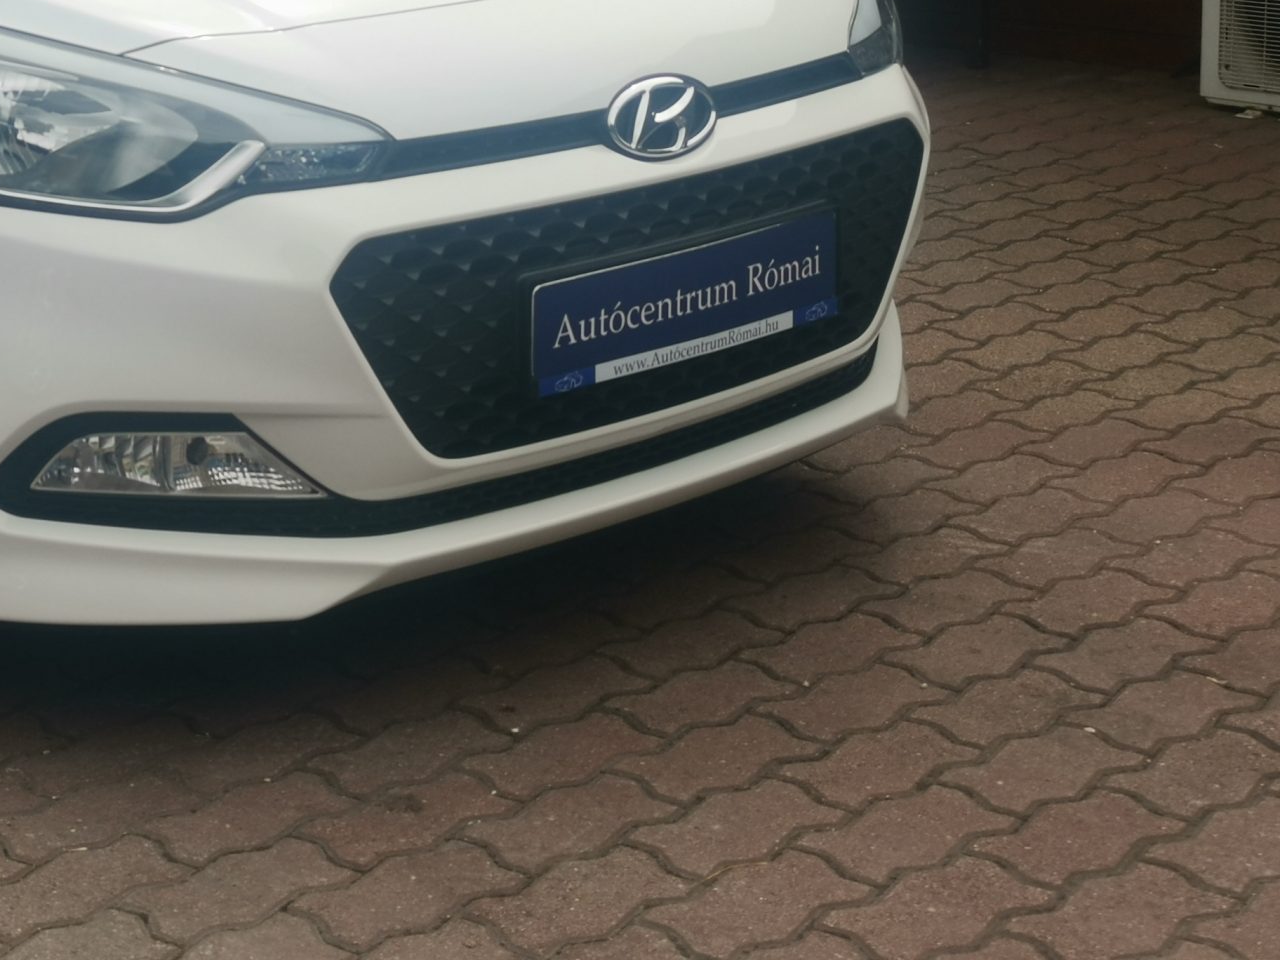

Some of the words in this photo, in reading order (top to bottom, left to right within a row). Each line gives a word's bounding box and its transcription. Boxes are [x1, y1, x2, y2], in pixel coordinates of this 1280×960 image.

[553, 280, 738, 349] Autócentrum
[746, 244, 821, 296] Római
[613, 319, 779, 377] www.AutócentrumRómai.hu
